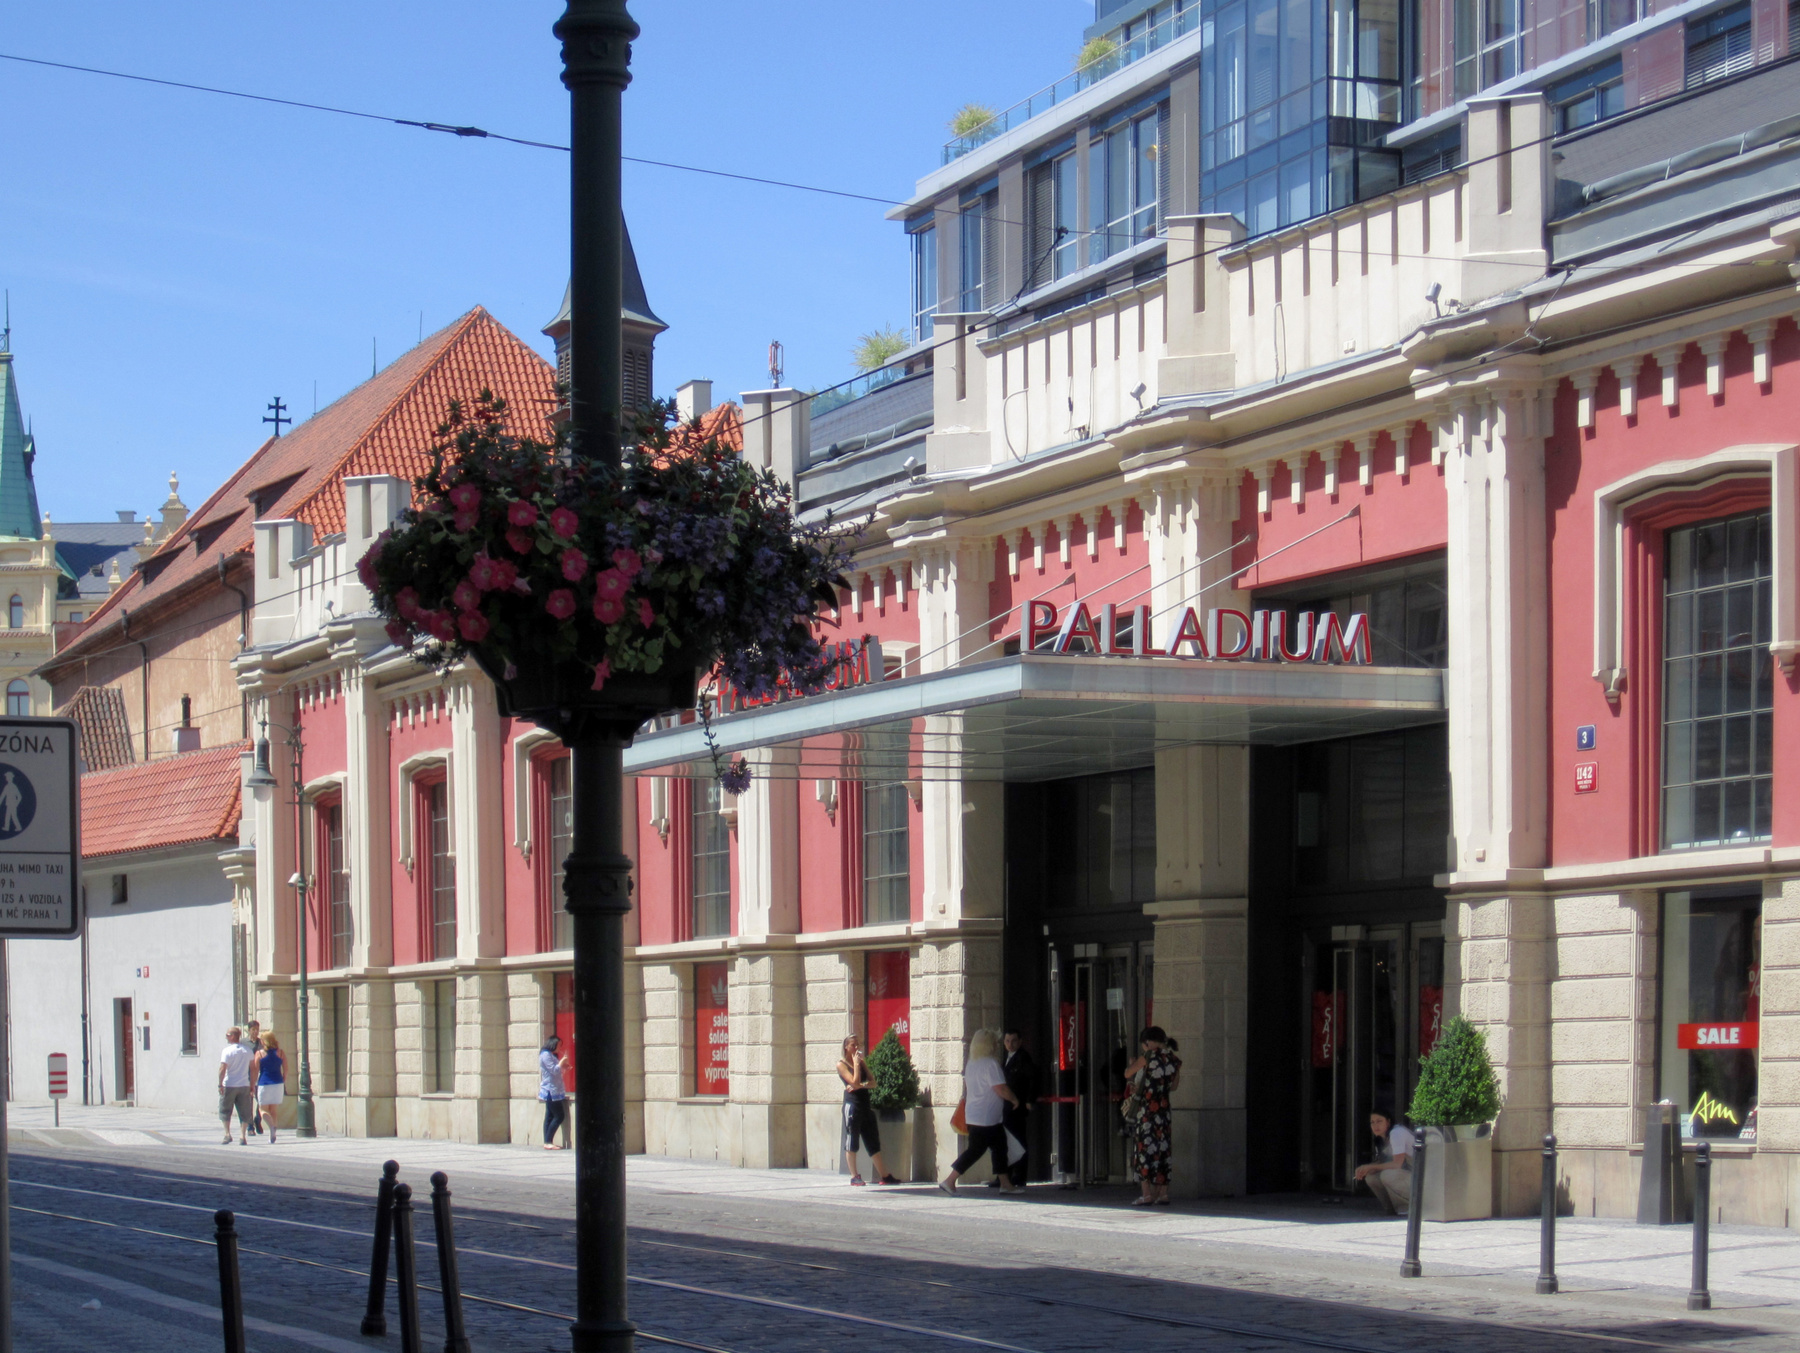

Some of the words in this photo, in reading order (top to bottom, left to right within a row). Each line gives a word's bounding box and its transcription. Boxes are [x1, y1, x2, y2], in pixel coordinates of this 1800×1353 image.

[1020, 600, 1373, 665] PALLADIUM
[0, 731, 54, 753] ZÓNA
[1581, 731, 1588, 744] 3
[1576, 766, 1593, 780] 1142
[19, 863, 41, 874] MIMO
[45, 864, 63, 875] TAXI
[10, 879, 15, 888] h
[2, 894, 15, 904] IZS
[19, 894, 24, 904] A
[29, 894, 63, 905] VOZIDLA
[23, 909, 51, 920] PRAHA
[54, 910, 59, 920] 1
[713, 1012, 728, 1027] sale
[1067, 1016, 1075, 1062] SALE
[1322, 1007, 1332, 1059] SALE
[1697, 1027, 1740, 1045] SALE
